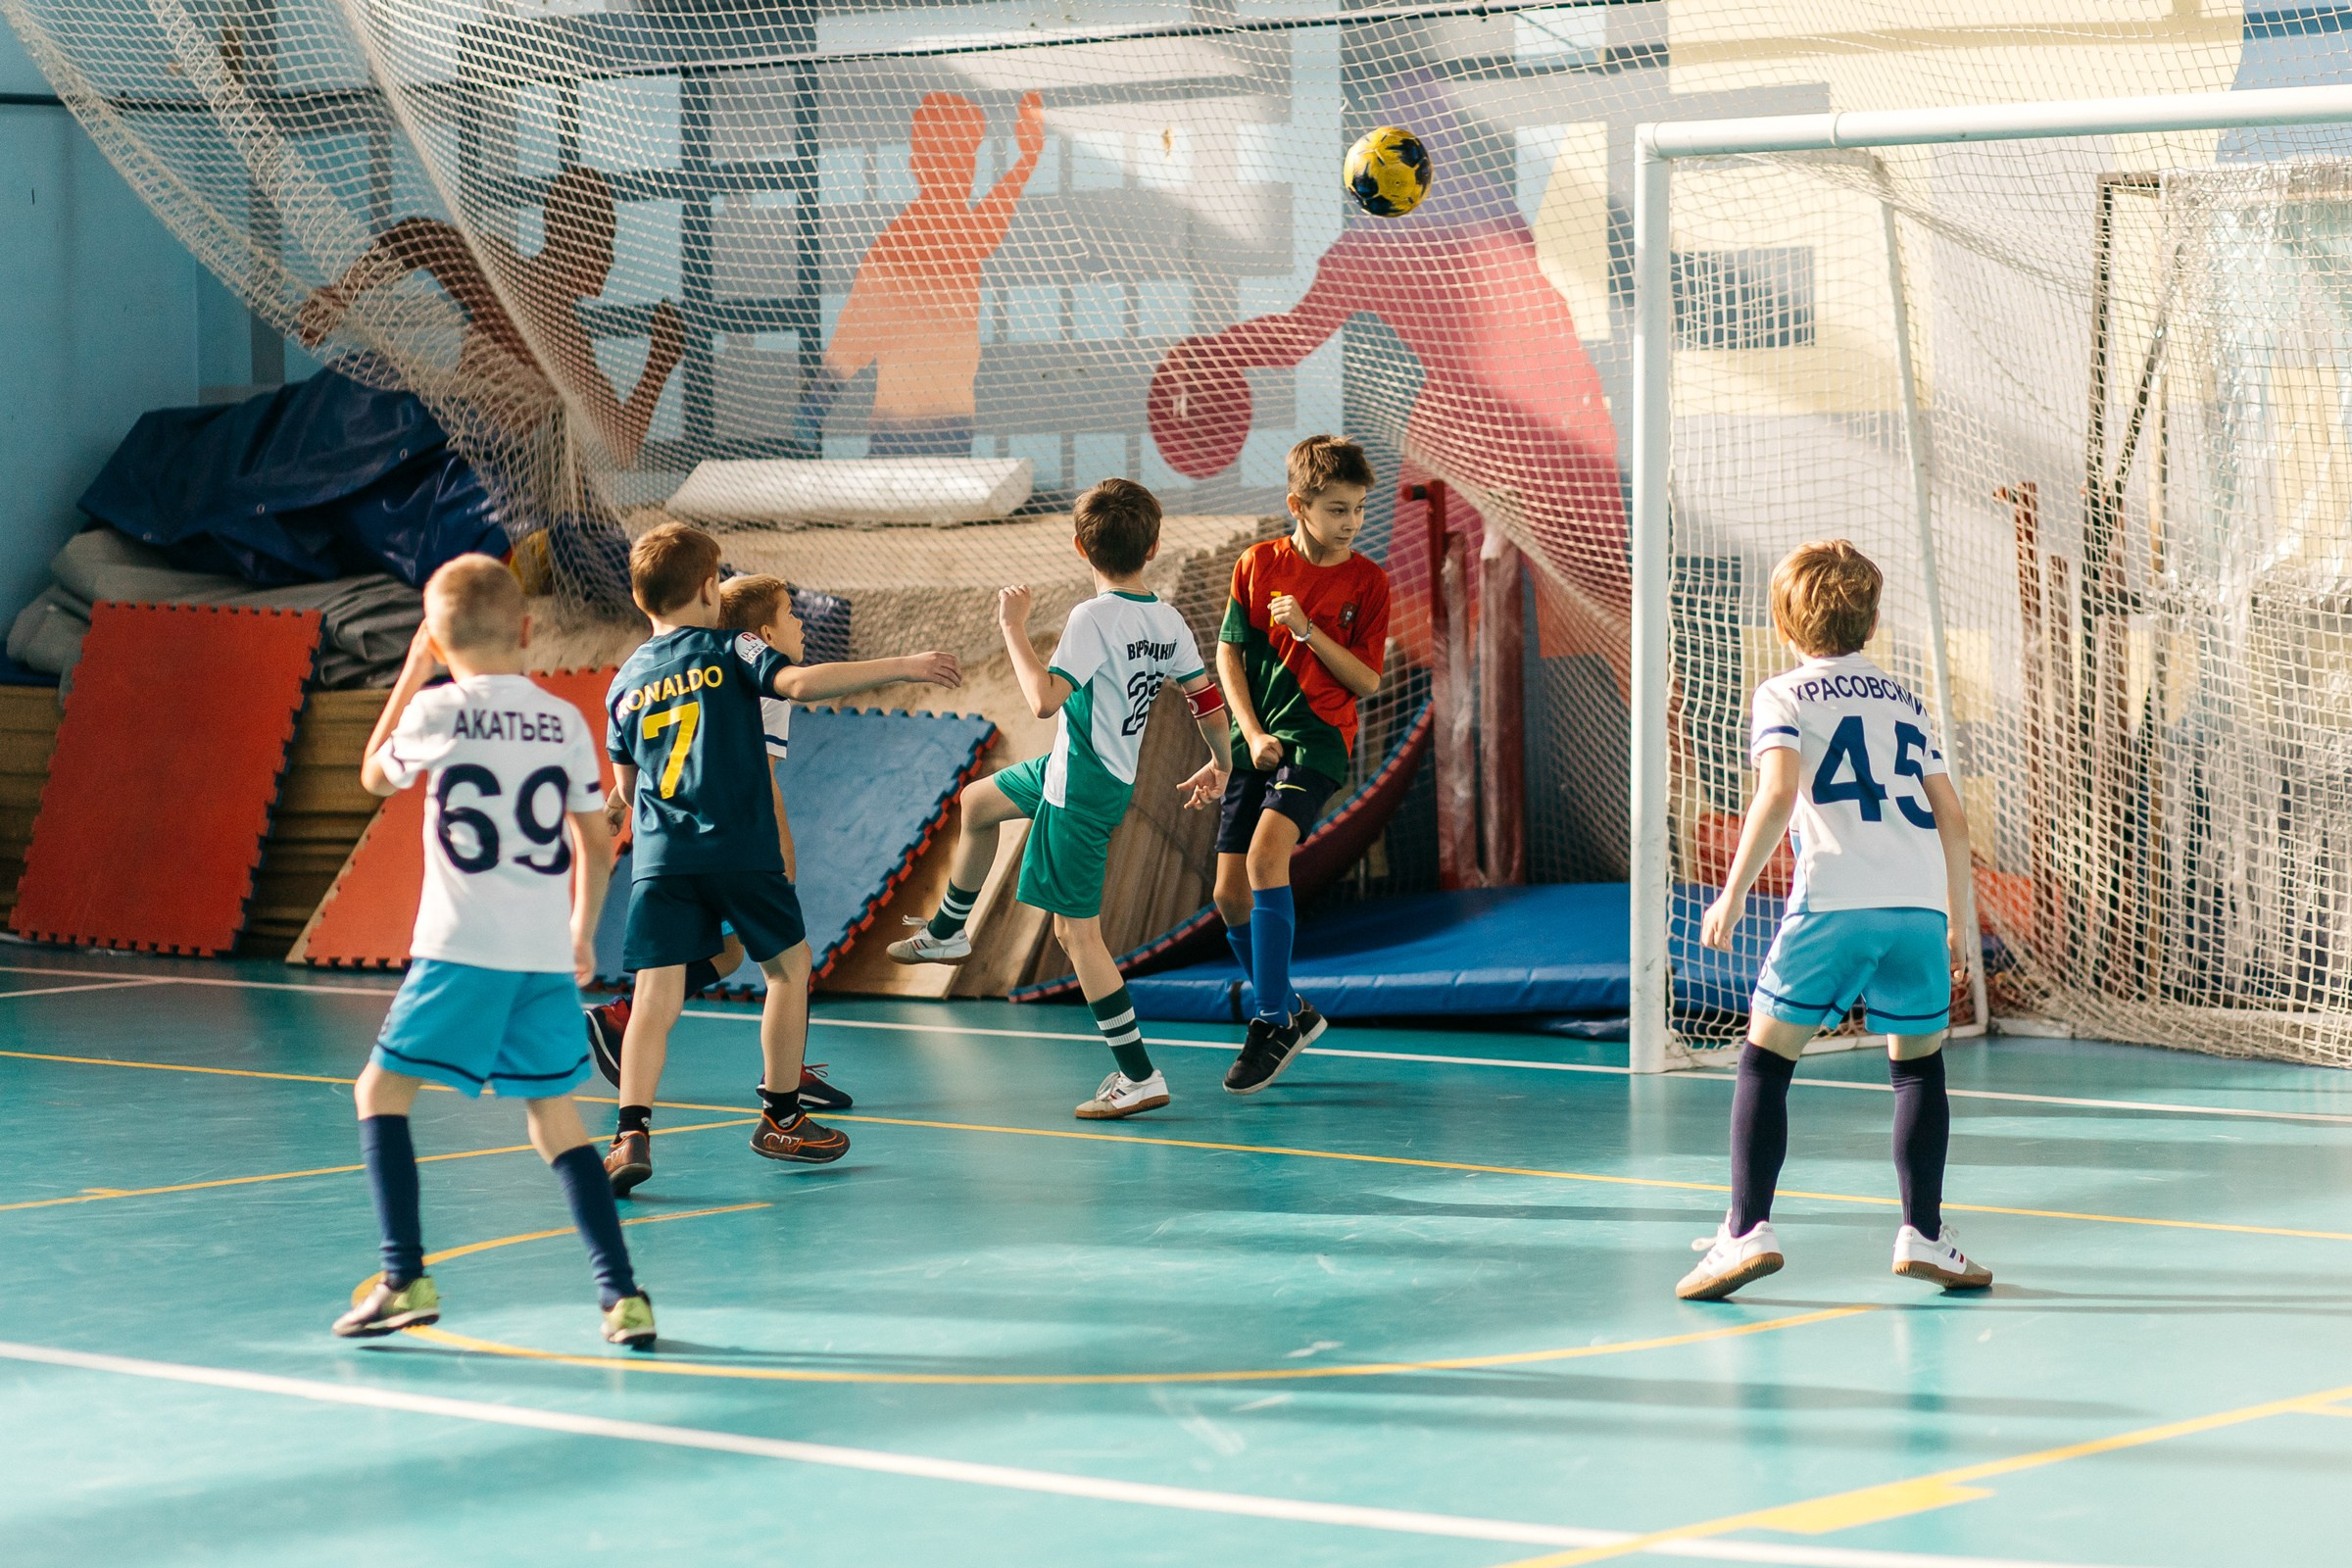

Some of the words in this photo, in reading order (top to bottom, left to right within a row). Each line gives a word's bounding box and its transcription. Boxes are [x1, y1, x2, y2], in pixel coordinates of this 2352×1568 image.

[453, 709, 564, 744] АКАТЬЕВ
[642, 702, 700, 800] 7
[1811, 715, 1937, 830] 45
[437, 763, 571, 875] 69
